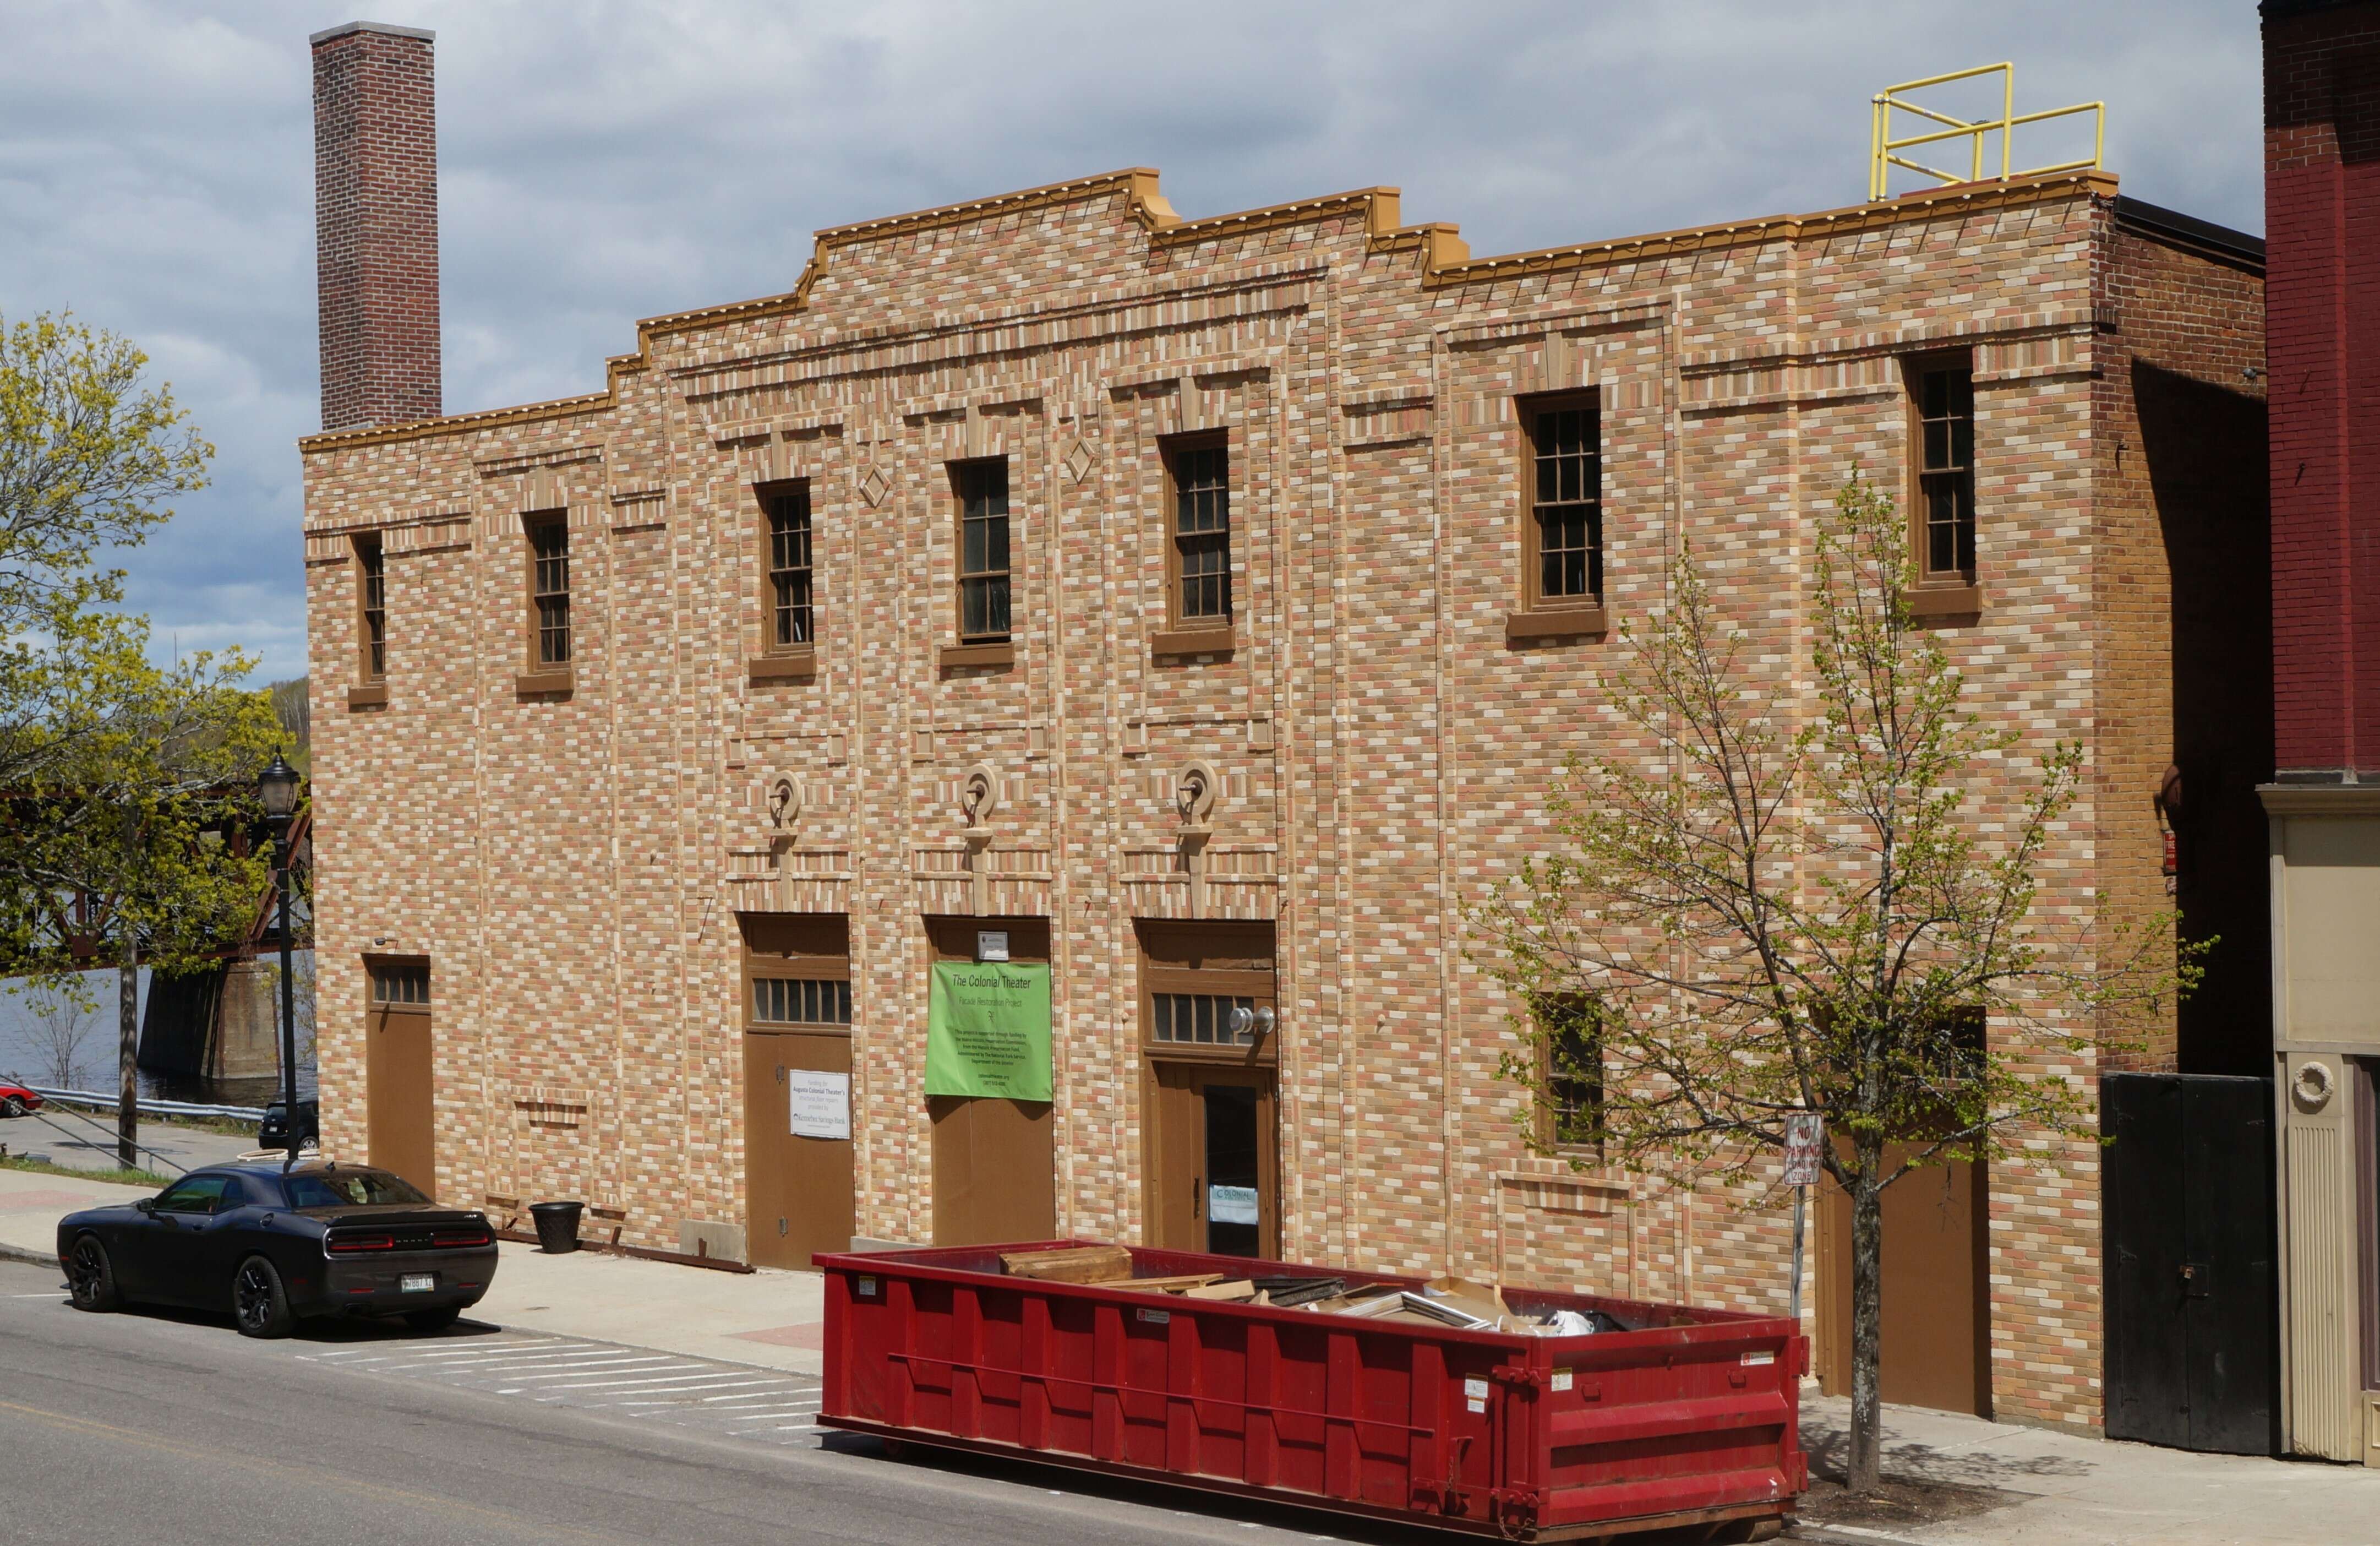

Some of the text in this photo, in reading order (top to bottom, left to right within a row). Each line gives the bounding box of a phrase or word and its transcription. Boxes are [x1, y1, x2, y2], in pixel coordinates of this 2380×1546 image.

[953, 974, 1031, 989] The Colonial Theater
[977, 997, 1005, 1006] Restoration
[1005, 998, 1022, 1008] Project
[1797, 1126, 1810, 1139] NO
[1787, 1145, 1820, 1158] PARKING
[1788, 1160, 1818, 1169] LOADING
[1793, 1171, 1812, 1180] ZONE
[1216, 1190, 1251, 1200] COLONIAL
